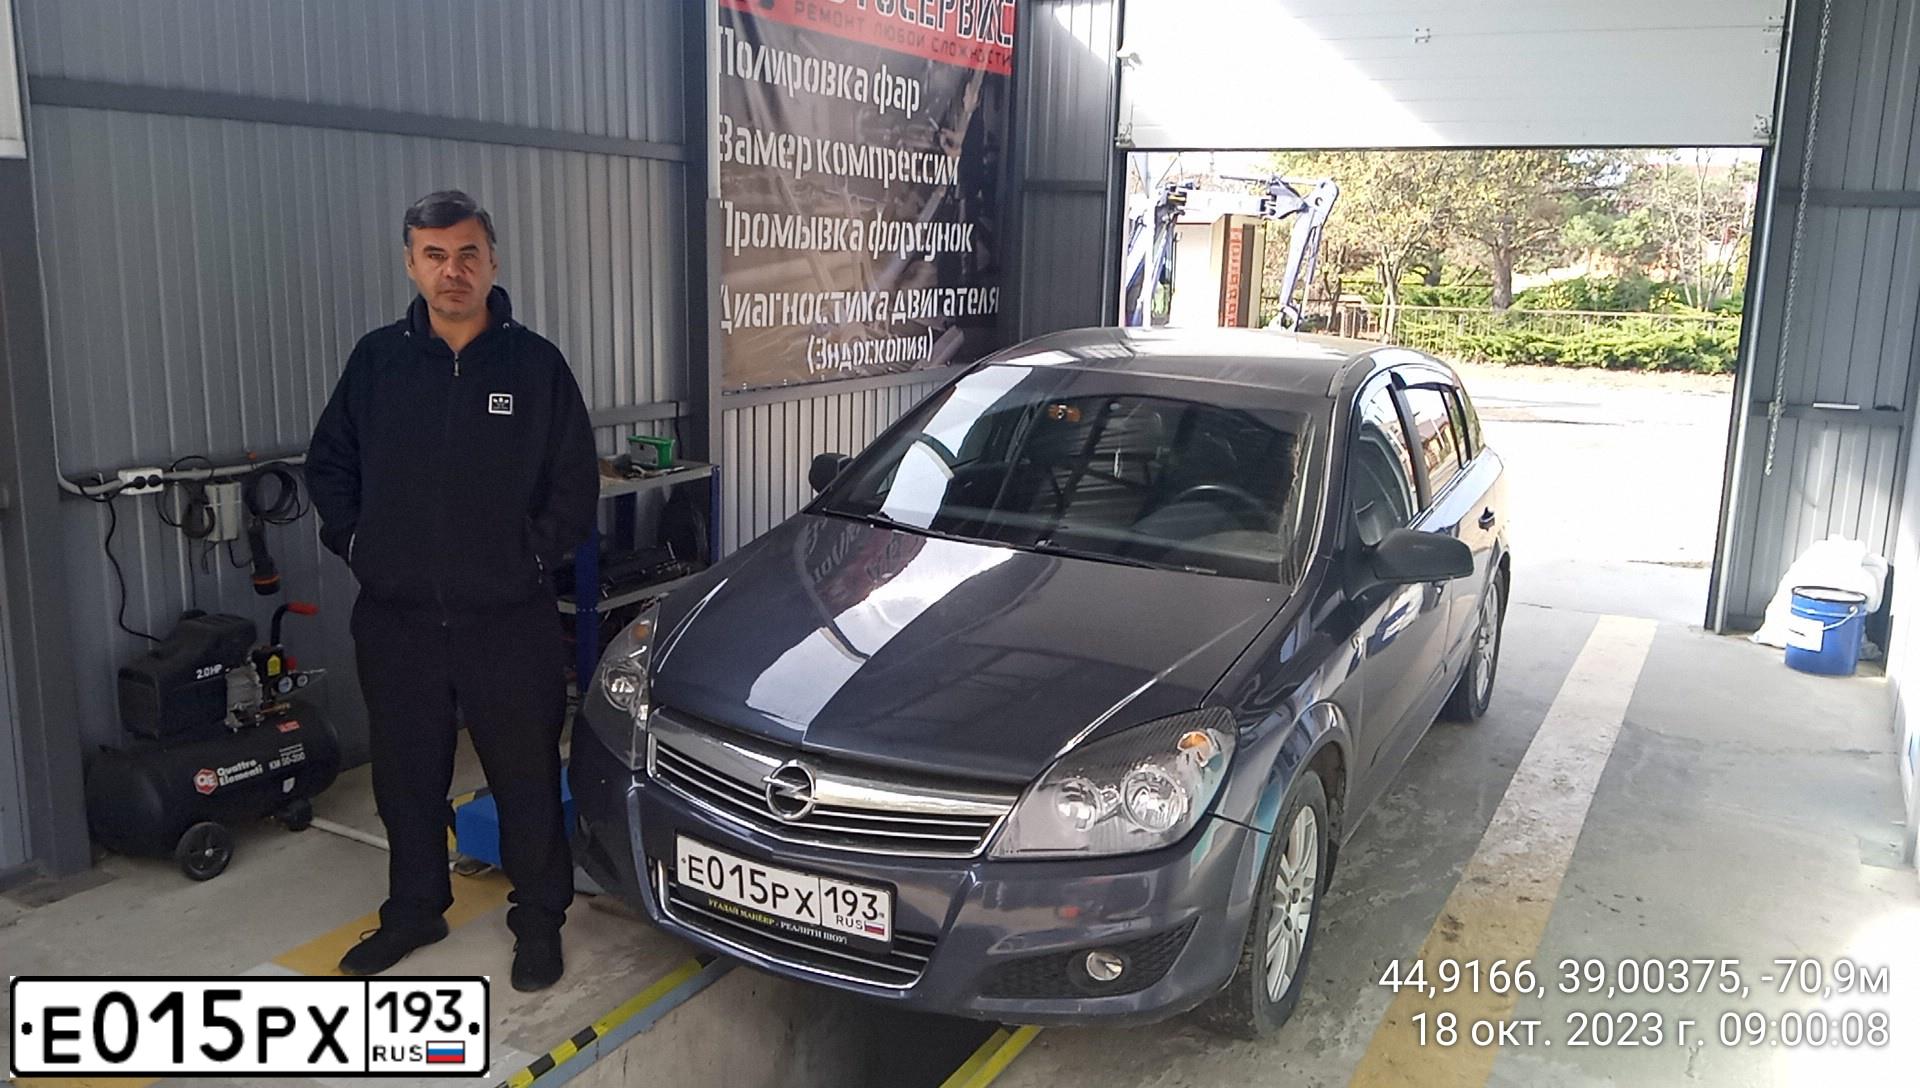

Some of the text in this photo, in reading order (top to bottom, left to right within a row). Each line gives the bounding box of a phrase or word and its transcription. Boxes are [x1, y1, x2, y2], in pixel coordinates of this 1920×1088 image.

[794, 0, 865, 33] РЕМОНТ
[719, 25, 920, 119] Полировка фар
[720, 114, 960, 189] Замер компрессии
[867, 211, 974, 262] форсунок
[891, 286, 999, 326] двигателя
[217, 759, 257, 777] Quattro
[219, 764, 263, 786] Elementi
[824, 886, 879, 921] 193
[836, 914, 863, 929] RUS
